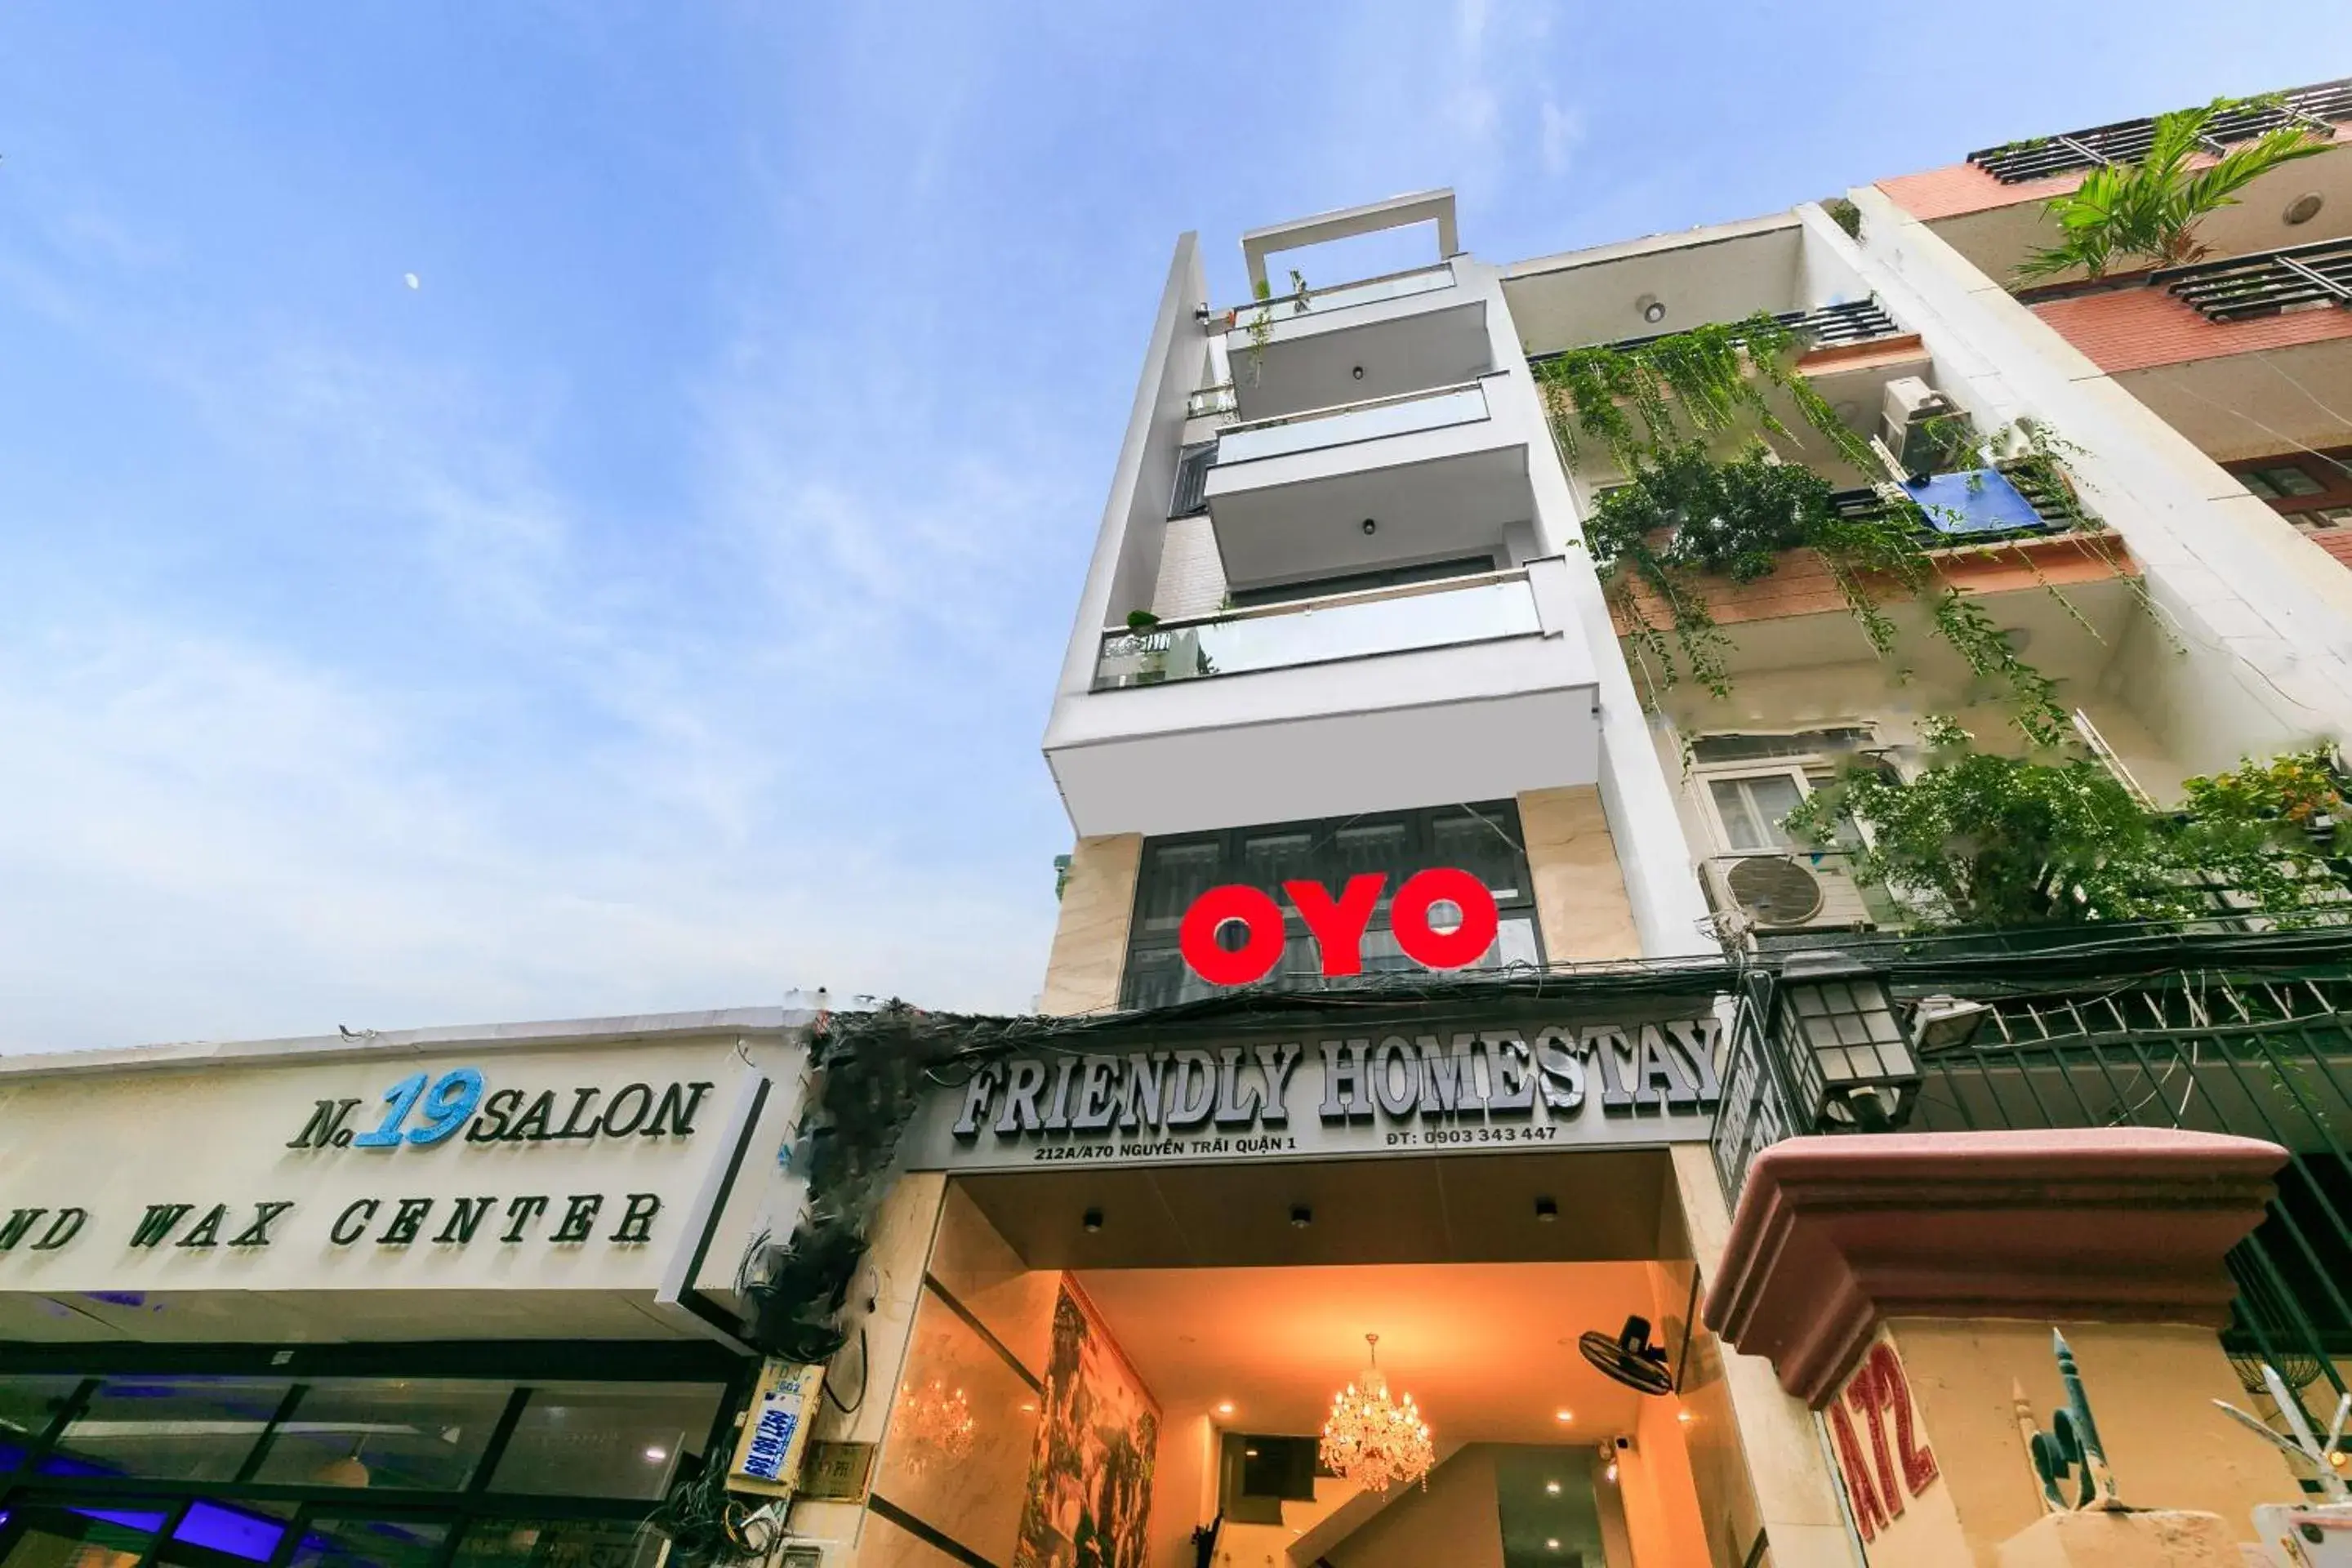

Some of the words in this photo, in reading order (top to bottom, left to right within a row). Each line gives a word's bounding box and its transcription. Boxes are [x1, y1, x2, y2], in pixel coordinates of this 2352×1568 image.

[1179, 867, 1498, 987] OYO
[952, 1042, 1302, 1139] FRIENDLY
[1319, 1018, 1722, 1124] HOMESTAY
[465, 1081, 715, 1143] SALON
[1424, 1129, 1472, 1144] 0903
[1478, 1128, 1517, 1142] 343
[1521, 1126, 1557, 1141] 447
[1034, 1143, 1114, 1160] 212A/A70
[1236, 1135, 1281, 1153] QUẬN
[1287, 1138, 1296, 1149] 1
[129, 1201, 295, 1247] WAX
[329, 1193, 662, 1245] CENTER
